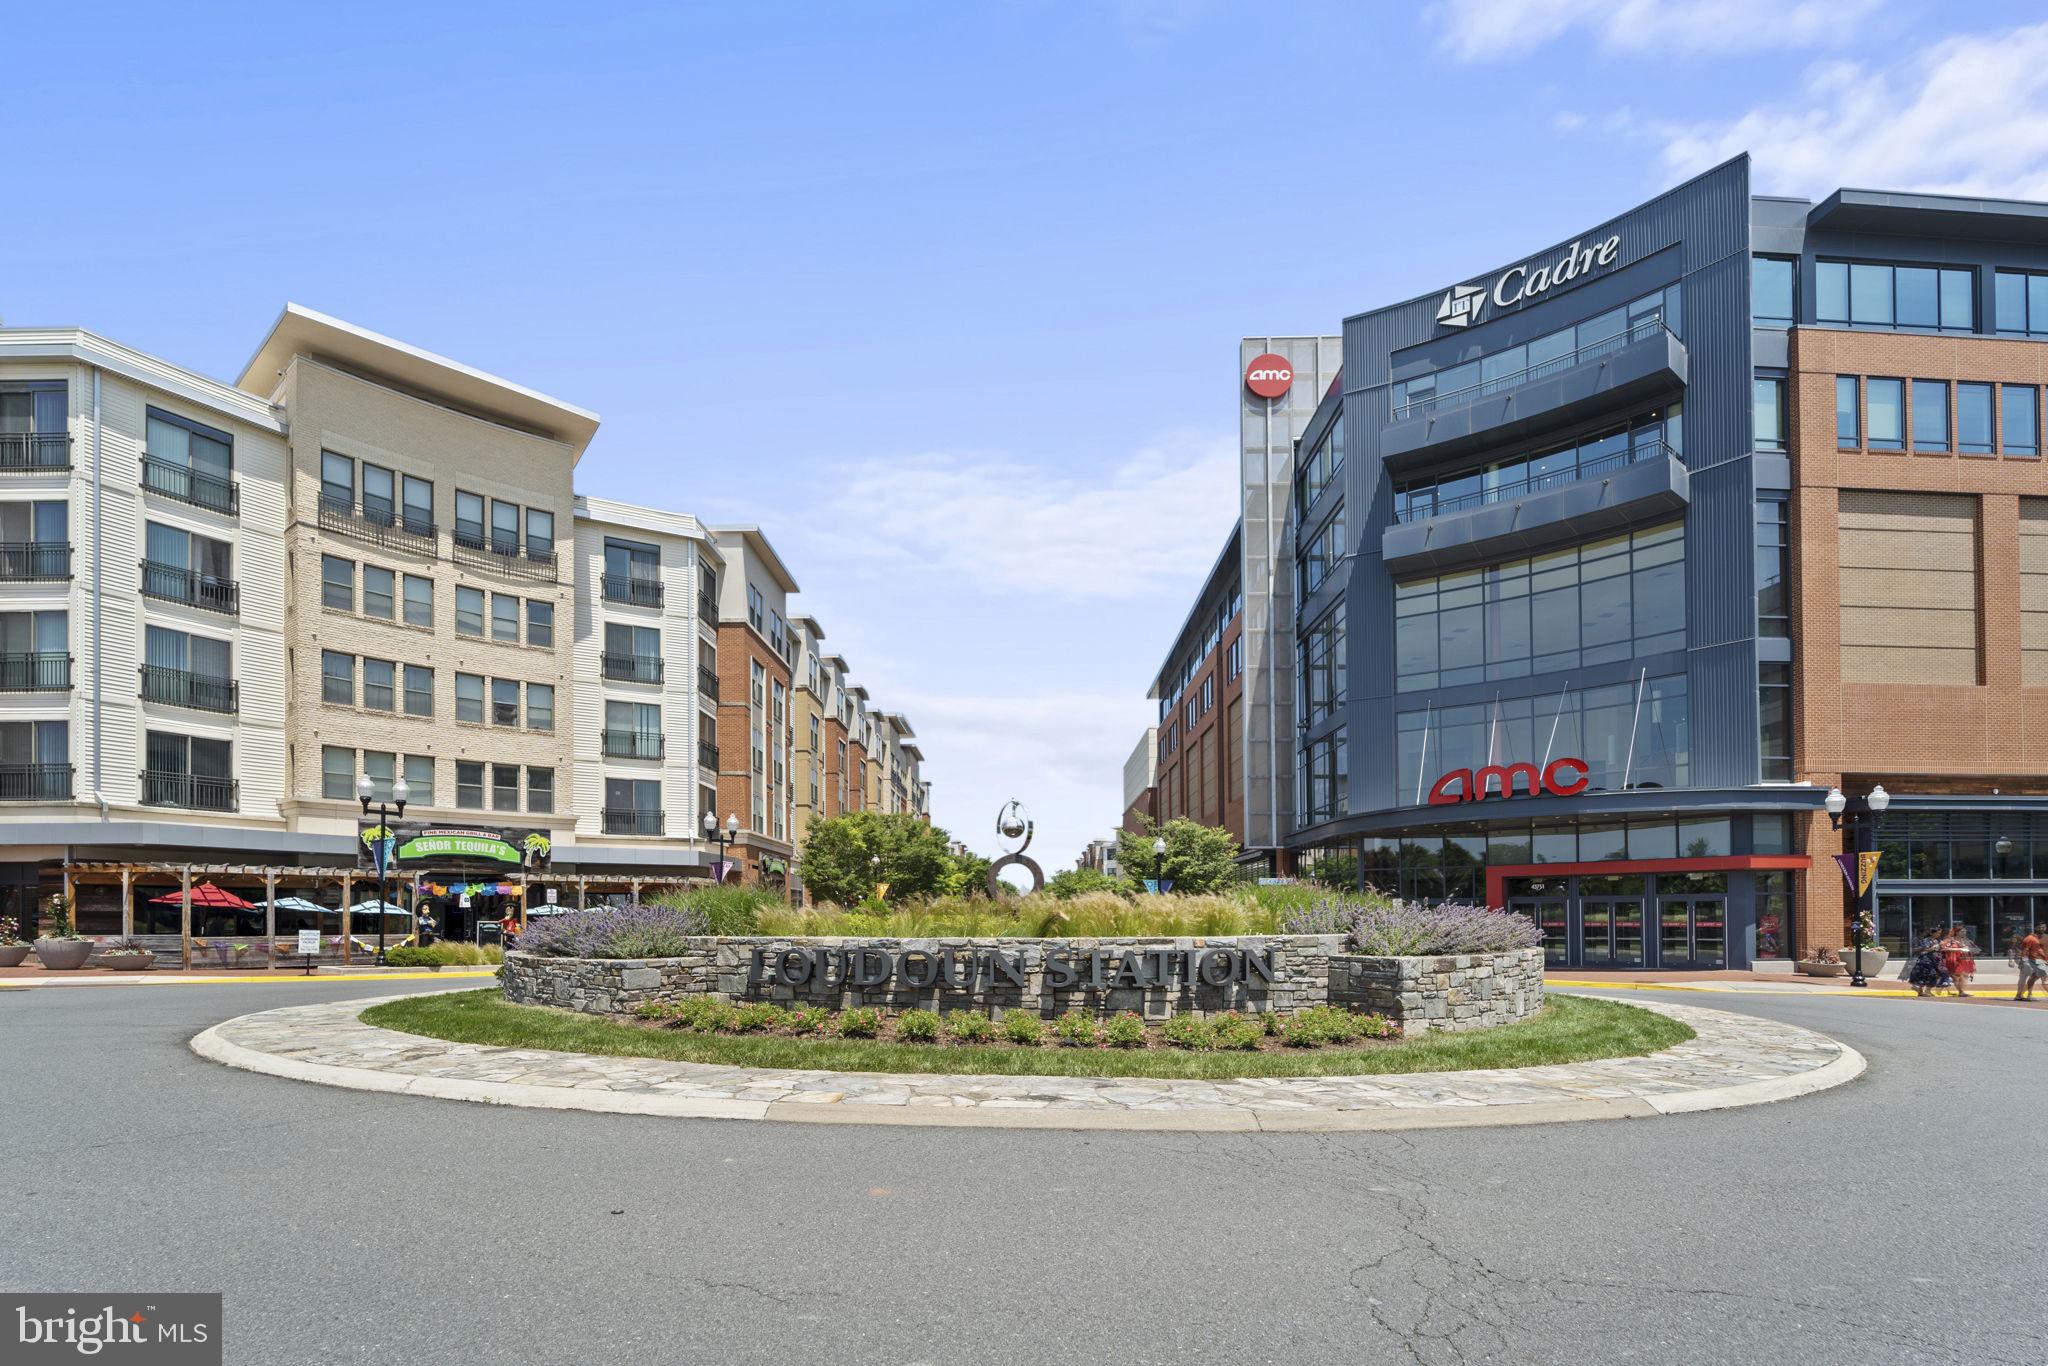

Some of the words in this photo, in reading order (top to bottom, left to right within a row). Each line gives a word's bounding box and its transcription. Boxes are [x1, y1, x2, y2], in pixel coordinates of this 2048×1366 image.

[1493, 235, 1621, 307] Cadre
[1249, 369, 1291, 381] amc
[1428, 757, 1590, 806] amc
[416, 840, 451, 852] SEÑOR
[455, 840, 506, 855] TEQUILA'S
[750, 948, 1026, 987] LOUDOUN
[1045, 948, 1277, 988] STATION
